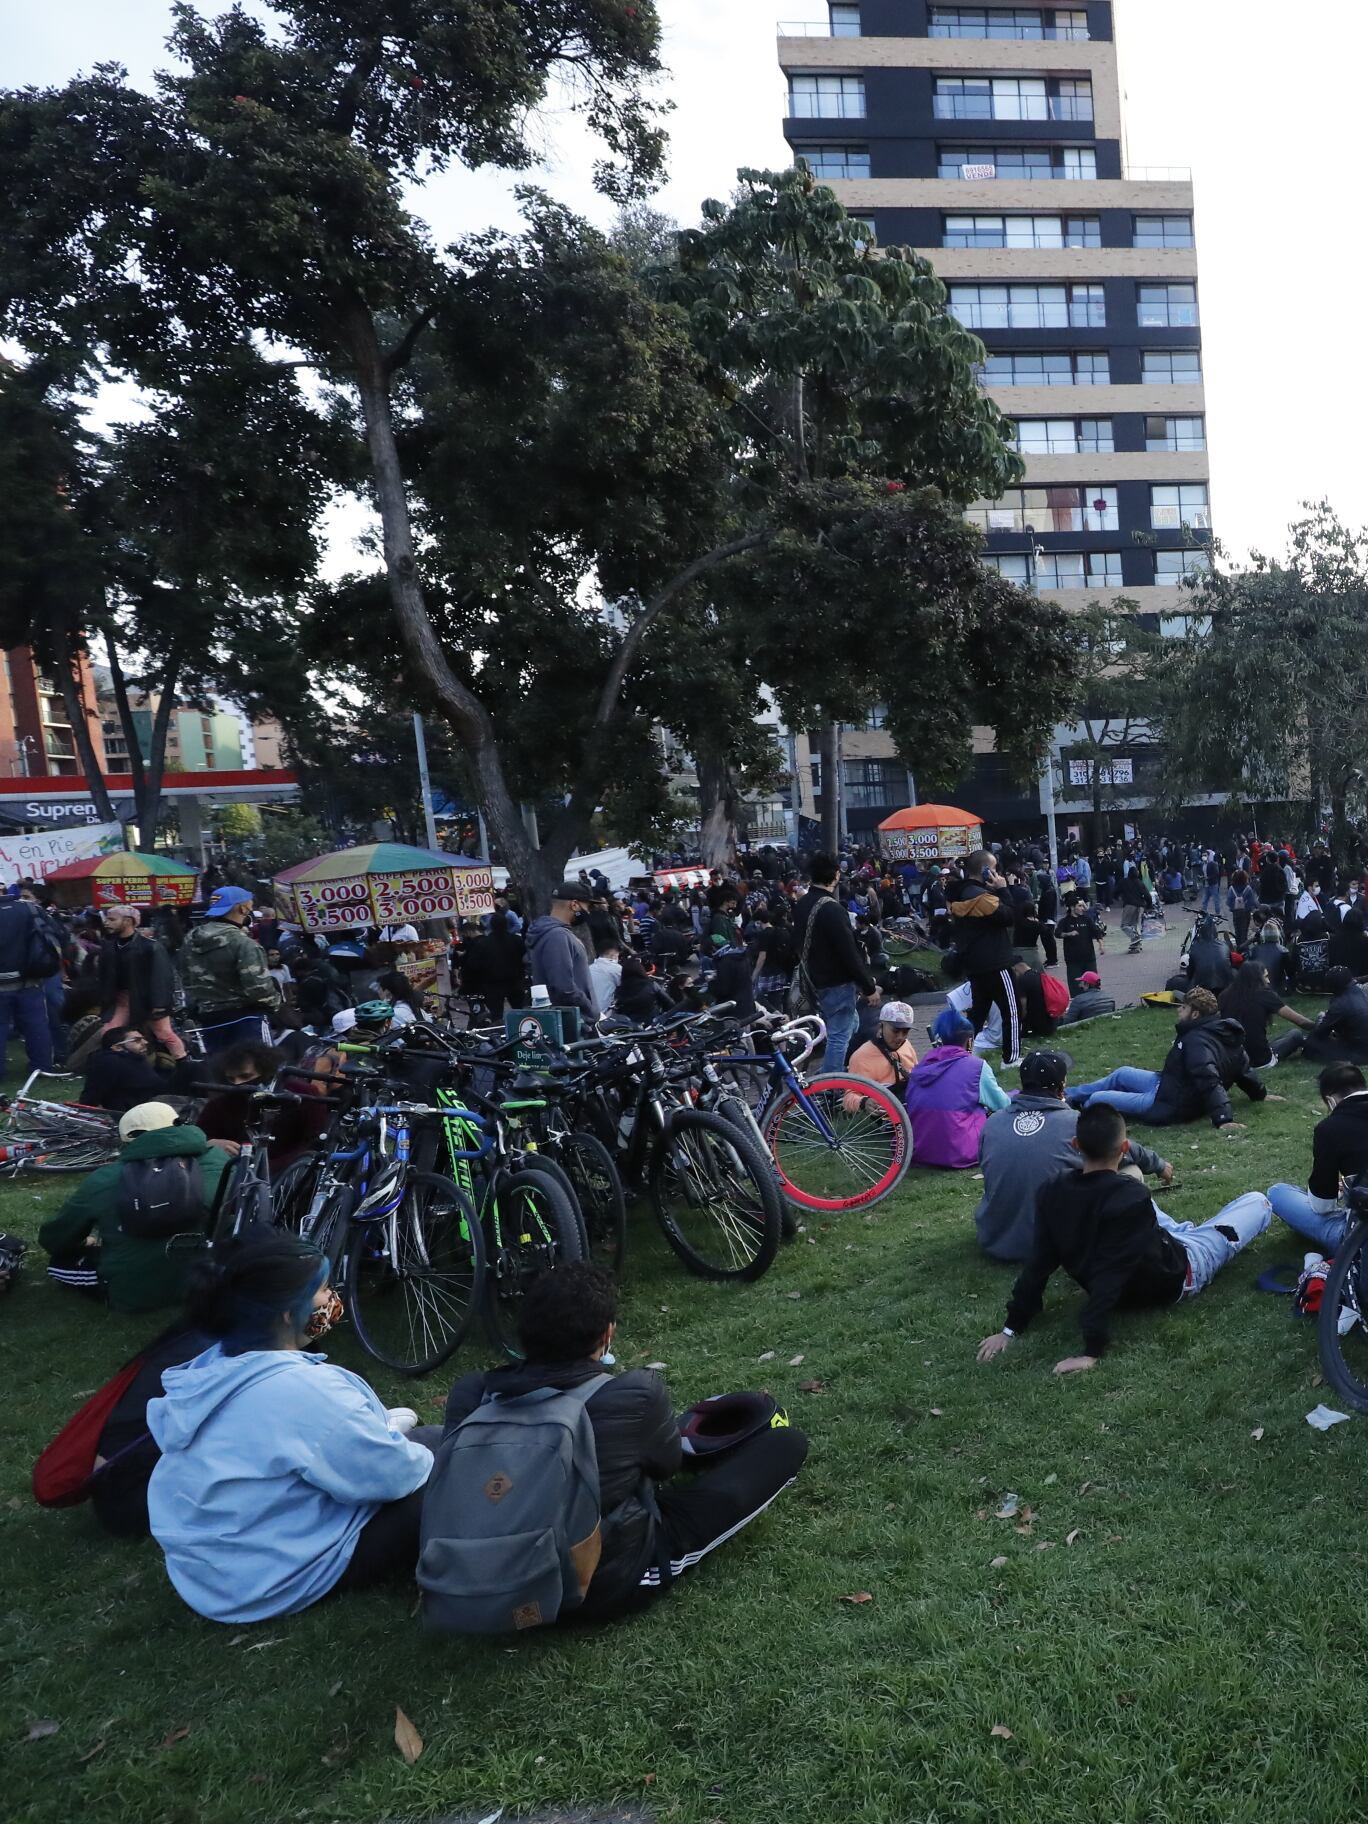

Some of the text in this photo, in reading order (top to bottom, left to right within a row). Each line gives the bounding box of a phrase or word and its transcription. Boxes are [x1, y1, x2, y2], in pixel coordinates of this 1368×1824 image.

[967, 171, 992, 179] VENDE
[908, 834, 938, 845] 3.000
[19, 846, 44, 860] en
[909, 847, 938, 858] 3.500
[375, 876, 450, 898] 2.500
[456, 873, 490, 889] 3.000
[300, 883, 367, 905] 3.000
[459, 893, 492, 910] 3.500
[379, 895, 454, 918] 3.000
[306, 905, 370, 927] 3.500
[517, 1050, 531, 1061] Deje
